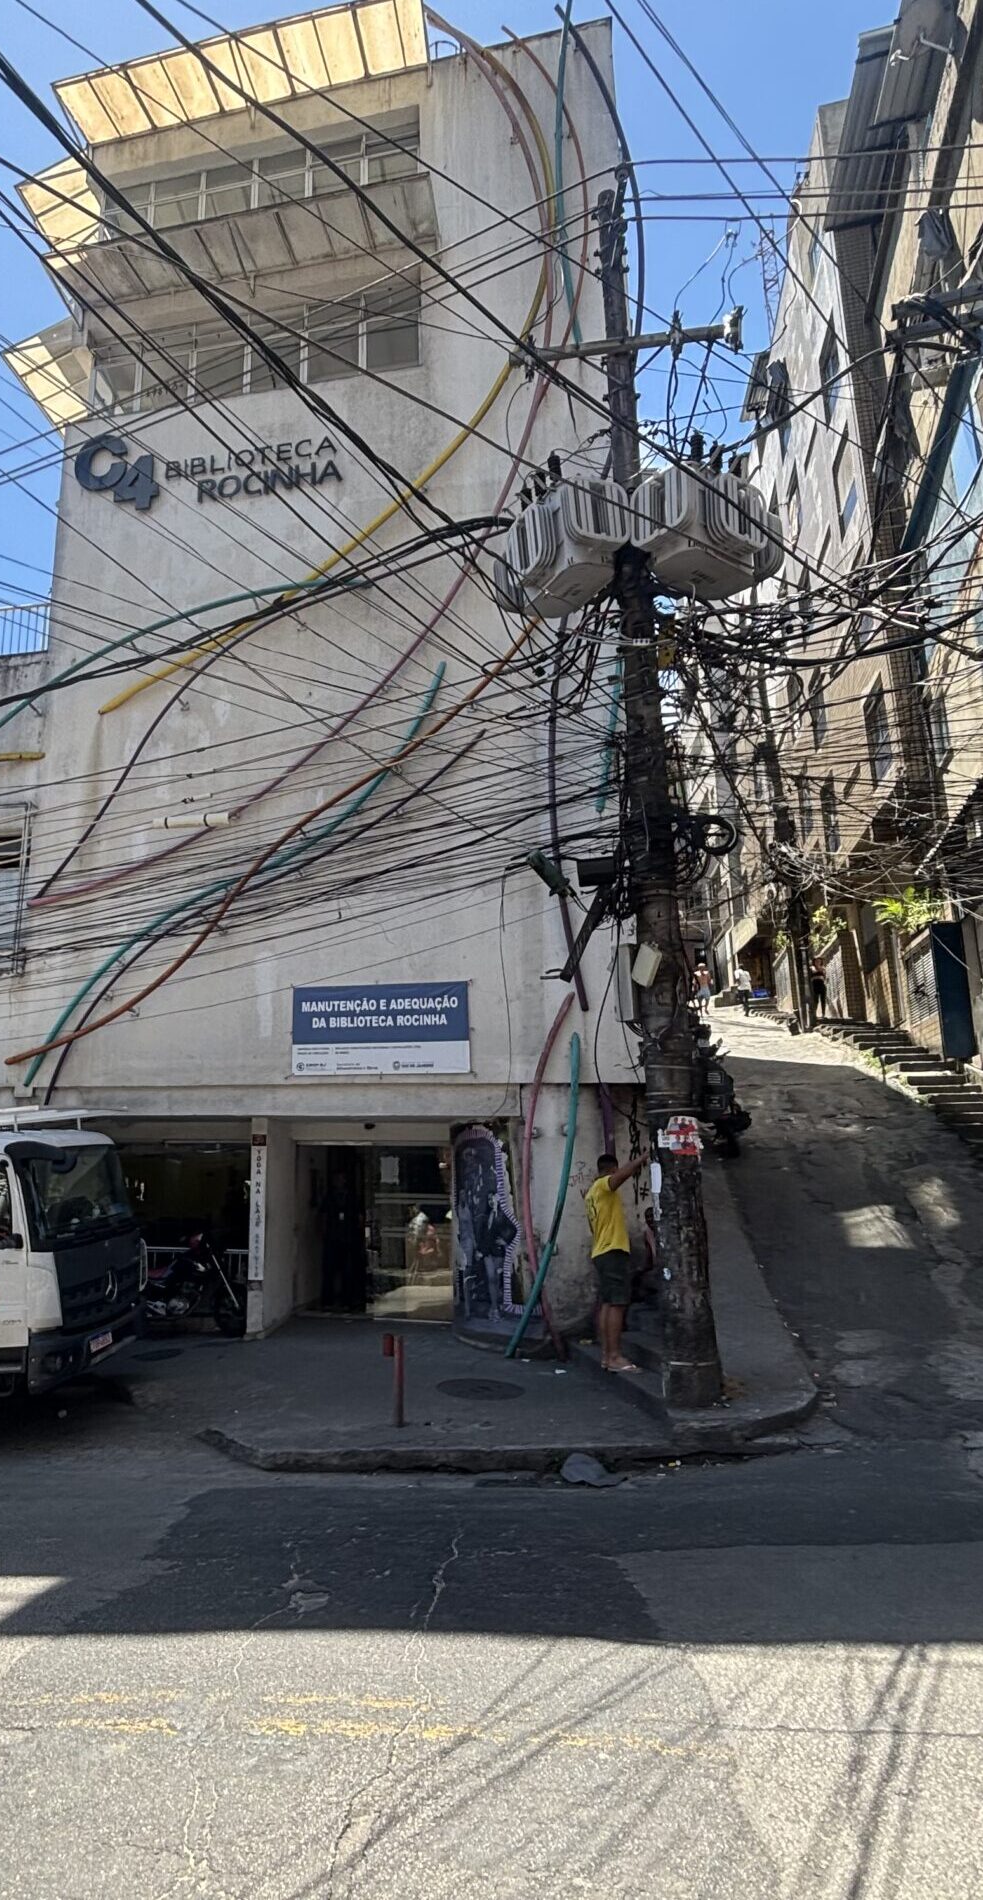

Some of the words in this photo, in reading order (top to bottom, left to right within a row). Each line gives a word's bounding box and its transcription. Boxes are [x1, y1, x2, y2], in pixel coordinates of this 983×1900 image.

[164, 436, 338, 480] BIBLIOTECA
[197, 460, 343, 504] ROCINHA
[301, 997, 377, 1014] MANUTENÇÃO
[379, 999, 387, 1010] E
[389, 995, 459, 1011] ADEQUAÇÃO
[312, 1017, 326, 1029] DA
[329, 1015, 394, 1028] BIBLIOTECA
[396, 1014, 447, 1026] ROCINHA
[255, 1181, 261, 1194] NA
